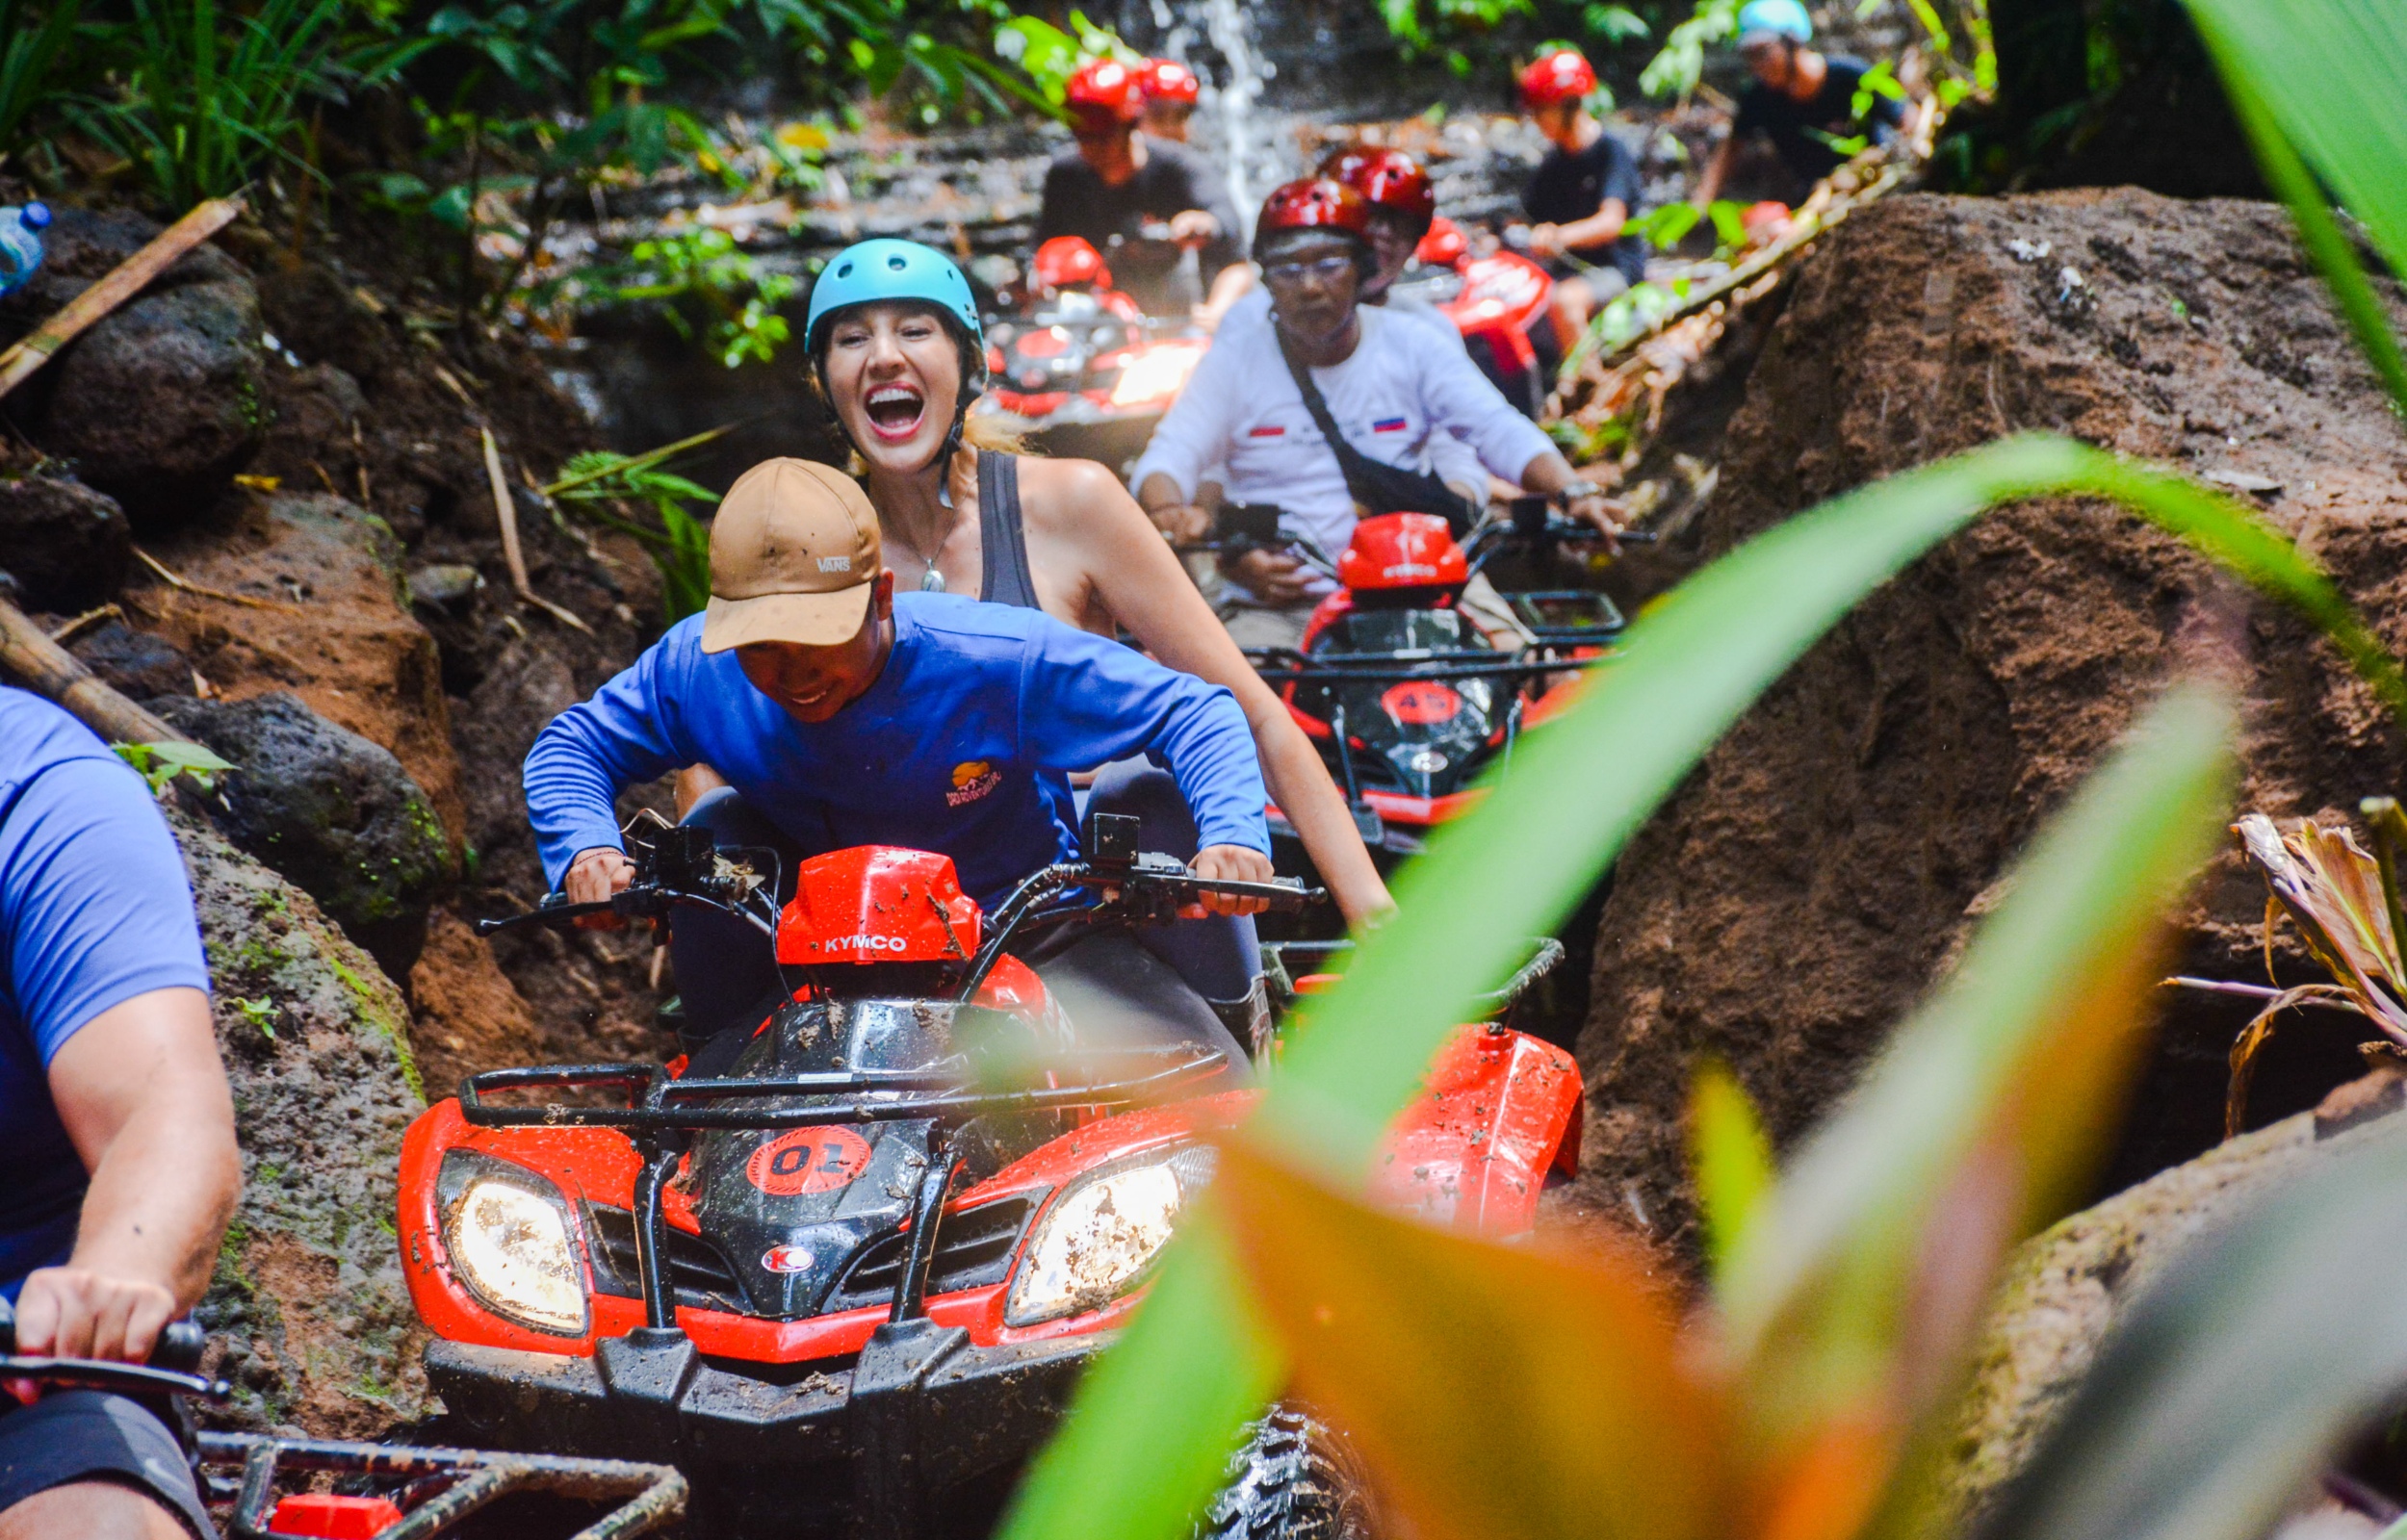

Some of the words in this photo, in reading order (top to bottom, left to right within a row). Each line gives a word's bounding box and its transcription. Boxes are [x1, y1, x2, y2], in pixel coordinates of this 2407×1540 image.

[815, 555, 851, 574] VANS
[825, 935, 907, 953] KYMCO
[771, 1143, 845, 1175] 01
